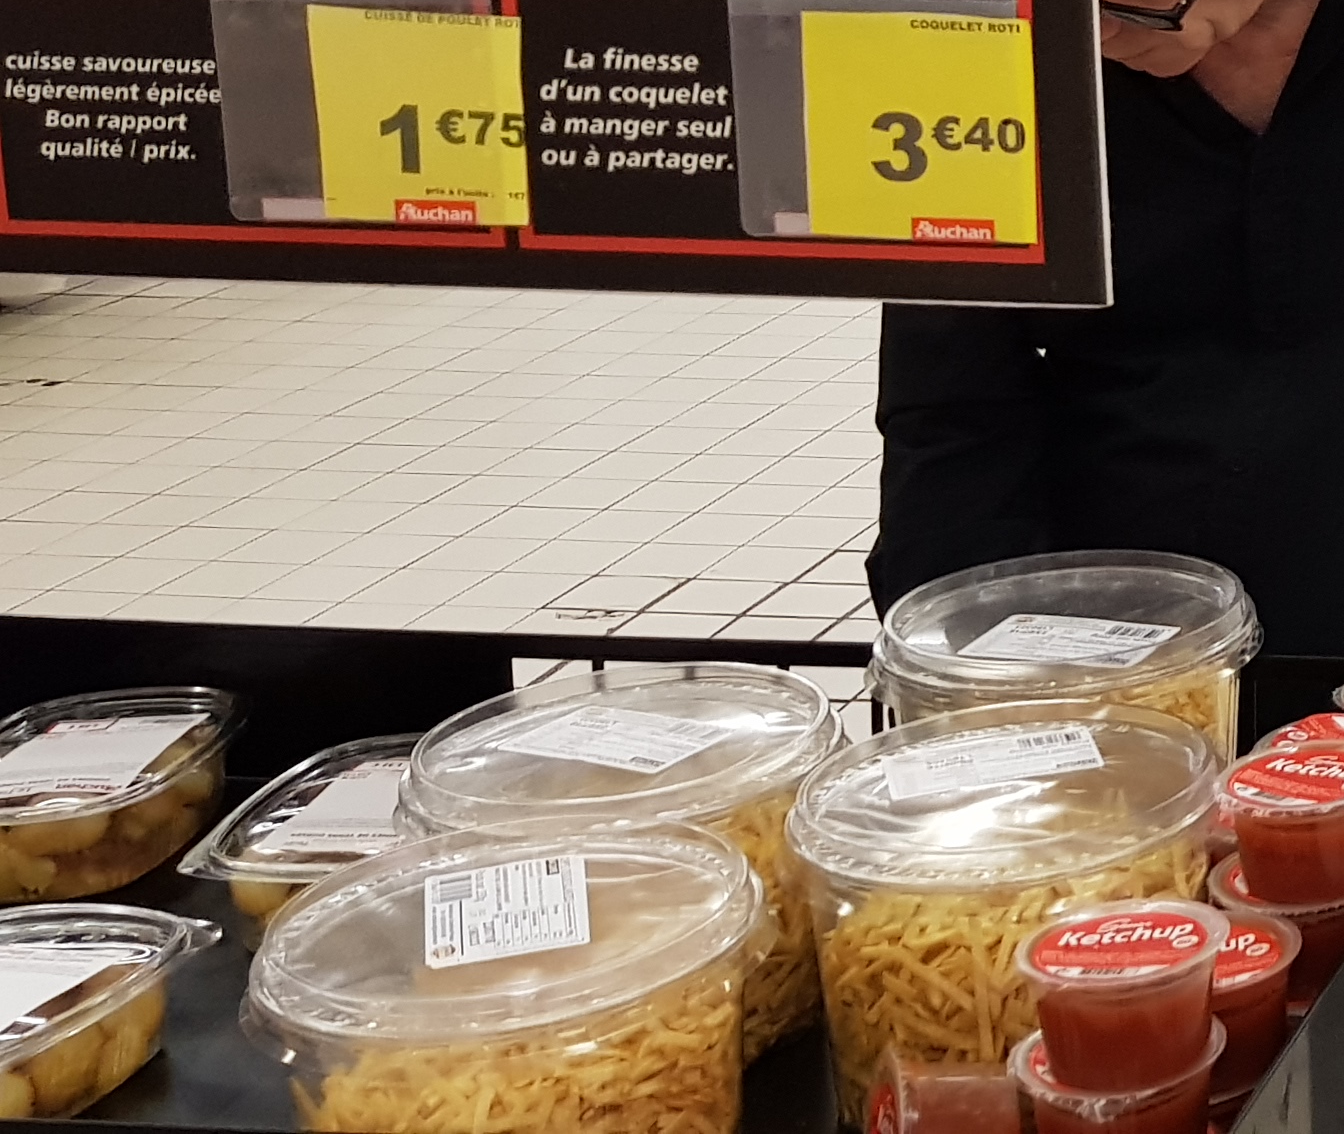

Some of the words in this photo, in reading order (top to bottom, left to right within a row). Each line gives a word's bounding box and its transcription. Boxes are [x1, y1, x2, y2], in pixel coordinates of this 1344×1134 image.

[910, 20, 984, 33] COQUELET
[988, 22, 1022, 34] ROTI
[5, 51, 76, 72] cuisse
[82, 54, 216, 75] savoureuse
[564, 49, 595, 69] La
[602, 48, 699, 72] finesse
[4, 78, 139, 105] légèrement
[146, 80, 221, 106] épicée
[607, 83, 728, 108] coquelet
[44, 109, 90, 130] Bon
[97, 112, 188, 136] rapport
[540, 112, 556, 133] à
[563, 117, 670, 140] manger
[675, 116, 731, 139] seul
[39, 137, 123, 161] qualité
[143, 138, 197, 163] prix.
[541, 147, 576, 166] ou
[583, 144, 600, 166] à
[607, 146, 734, 173] partager.
[399, 201, 474, 222] Auchan
[914, 220, 992, 241] Auchan
[1057, 921, 1195, 948] Ketchup
